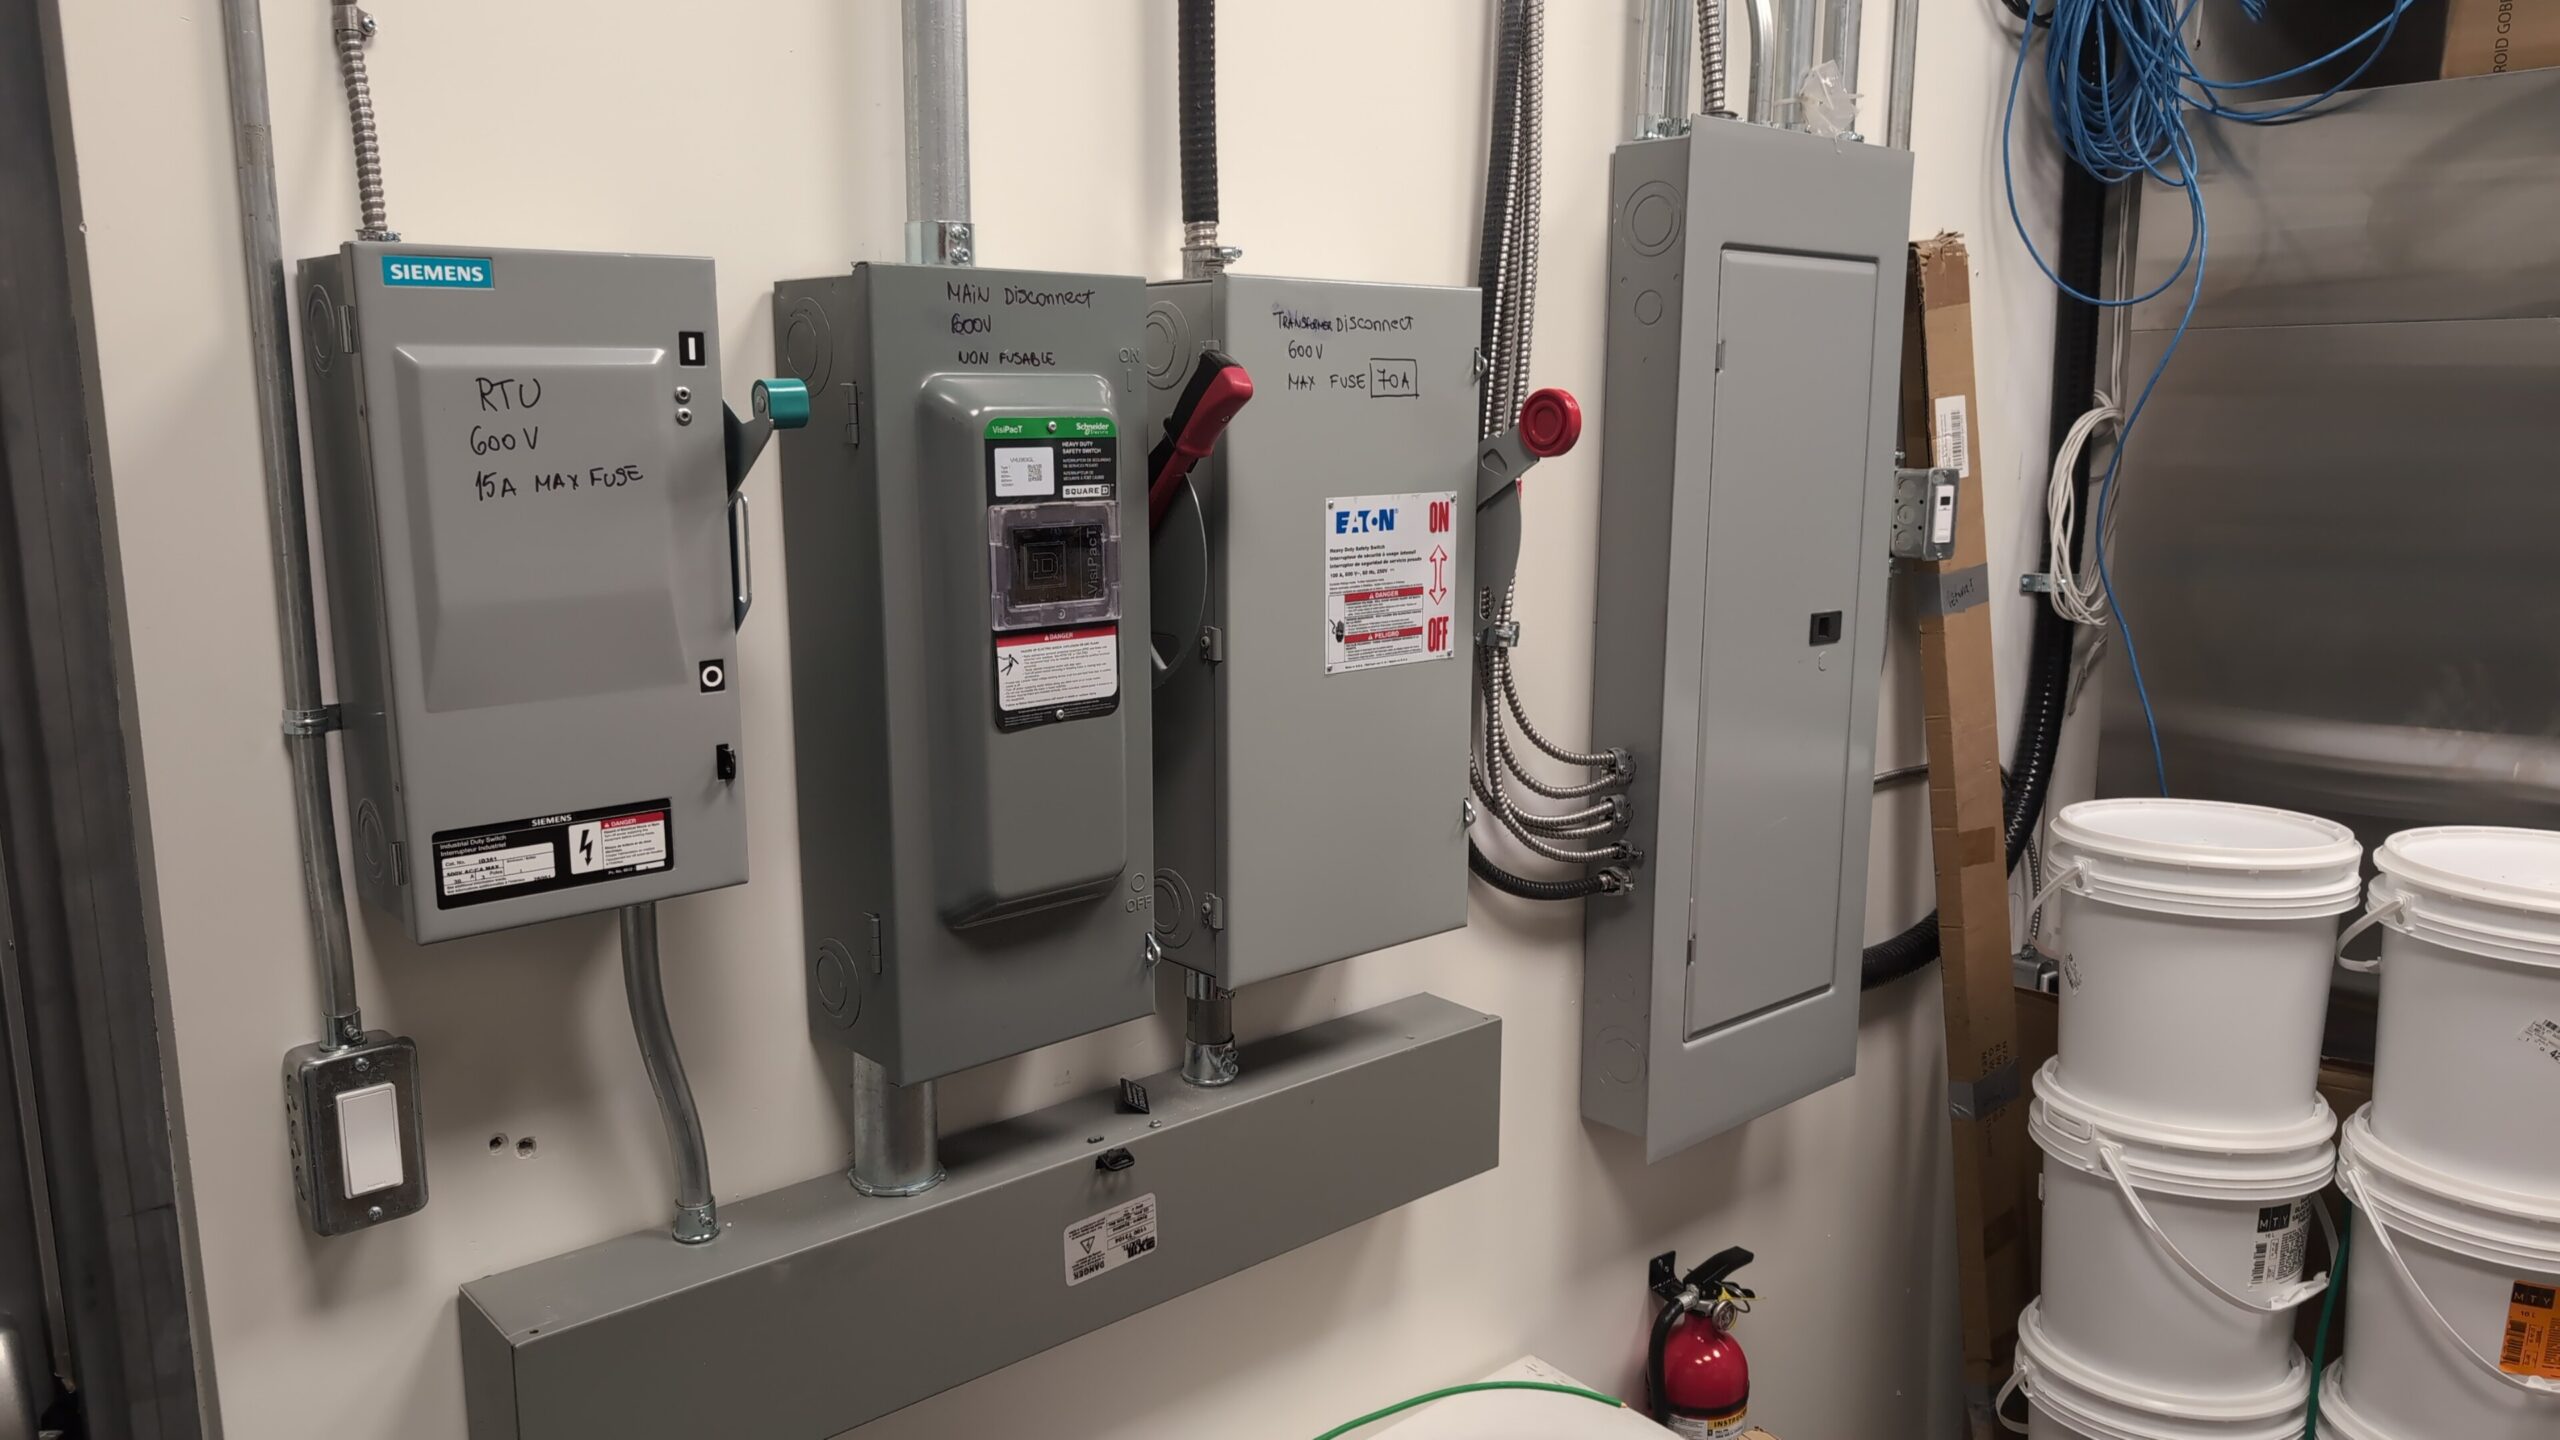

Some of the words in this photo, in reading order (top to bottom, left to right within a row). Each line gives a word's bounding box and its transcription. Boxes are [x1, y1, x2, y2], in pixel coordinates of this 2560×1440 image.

[2497, 0, 2512, 34] GOB
[390, 263, 484, 283] SIEMENS
[958, 351, 989, 365] NON
[999, 350, 1055, 366] FUSABLE
[1288, 374, 1316, 391] MAX
[1330, 373, 1366, 389] FUSE
[475, 377, 541, 412] RTU
[992, 425, 1023, 434] VisiPacT
[1076, 422, 1109, 431] Schneider
[535, 474, 579, 493] MAX
[590, 465, 643, 487] FUSE
[1065, 487, 1100, 495] SQUARE
[1336, 509, 1395, 534] EATON
[1429, 502, 1449, 533] ON
[1375, 590, 1398, 598] DANGER
[1049, 632, 1073, 640] DANGER
[1375, 631, 1400, 639] PELIGRO
[1428, 616, 1449, 653] OFF
[531, 814, 572, 827] SIEMENS
[611, 818, 637, 827] DANGER
[440, 840, 469, 850] Industrial
[470, 838, 484, 846] Duty
[486, 835, 507, 843] Switch
[440, 846, 477, 857] Interrupteur
[1125, 895, 1152, 913] OFF
[1073, 1261, 1105, 1280] DANGER
